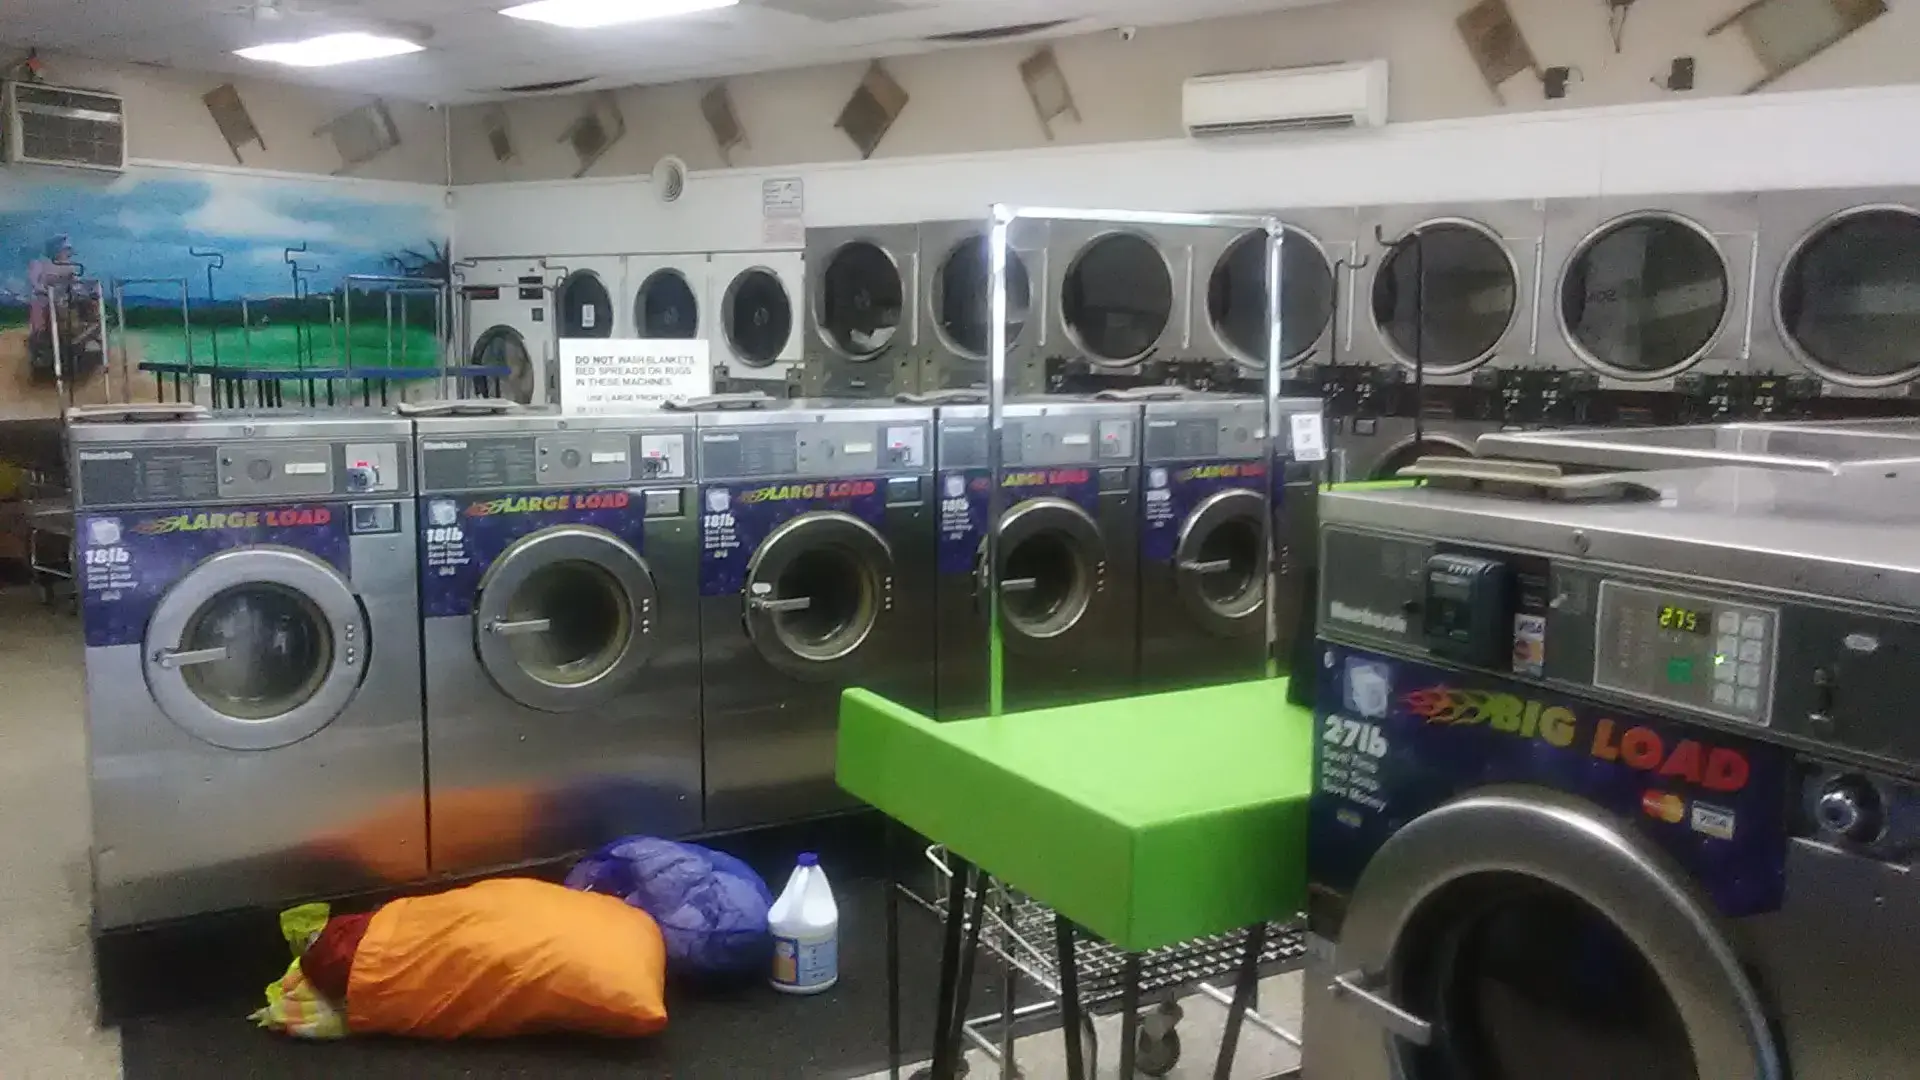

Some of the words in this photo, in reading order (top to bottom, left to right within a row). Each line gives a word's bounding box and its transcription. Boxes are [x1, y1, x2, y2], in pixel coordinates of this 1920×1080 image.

[575, 356, 590, 364] DO
[593, 356, 614, 364] NOT
[618, 356, 644, 364] WASH
[647, 355, 695, 364] BLANKETS
[575, 367, 596, 375] BED
[599, 366, 645, 375] SPREADS
[648, 366, 662, 374] OR
[665, 366, 692, 374] RUGS
[575, 378, 585, 386] IN
[588, 378, 620, 386] THESE
[769, 483, 825, 500] LARGE
[828, 480, 876, 497] LOAD
[502, 495, 570, 513] LARGE
[575, 491, 629, 509] LOAD
[179, 511, 260, 531] LARGE
[265, 507, 332, 526] LOAD
[703, 513, 735, 528] 18lb
[427, 527, 464, 542] 18lb
[85, 548, 130, 564] 18lb
[1659, 607, 1697, 631] 275
[1322, 713, 1389, 759] 27lb
[1488, 691, 1577, 747] BIG
[1591, 718, 1750, 791] LOAD
